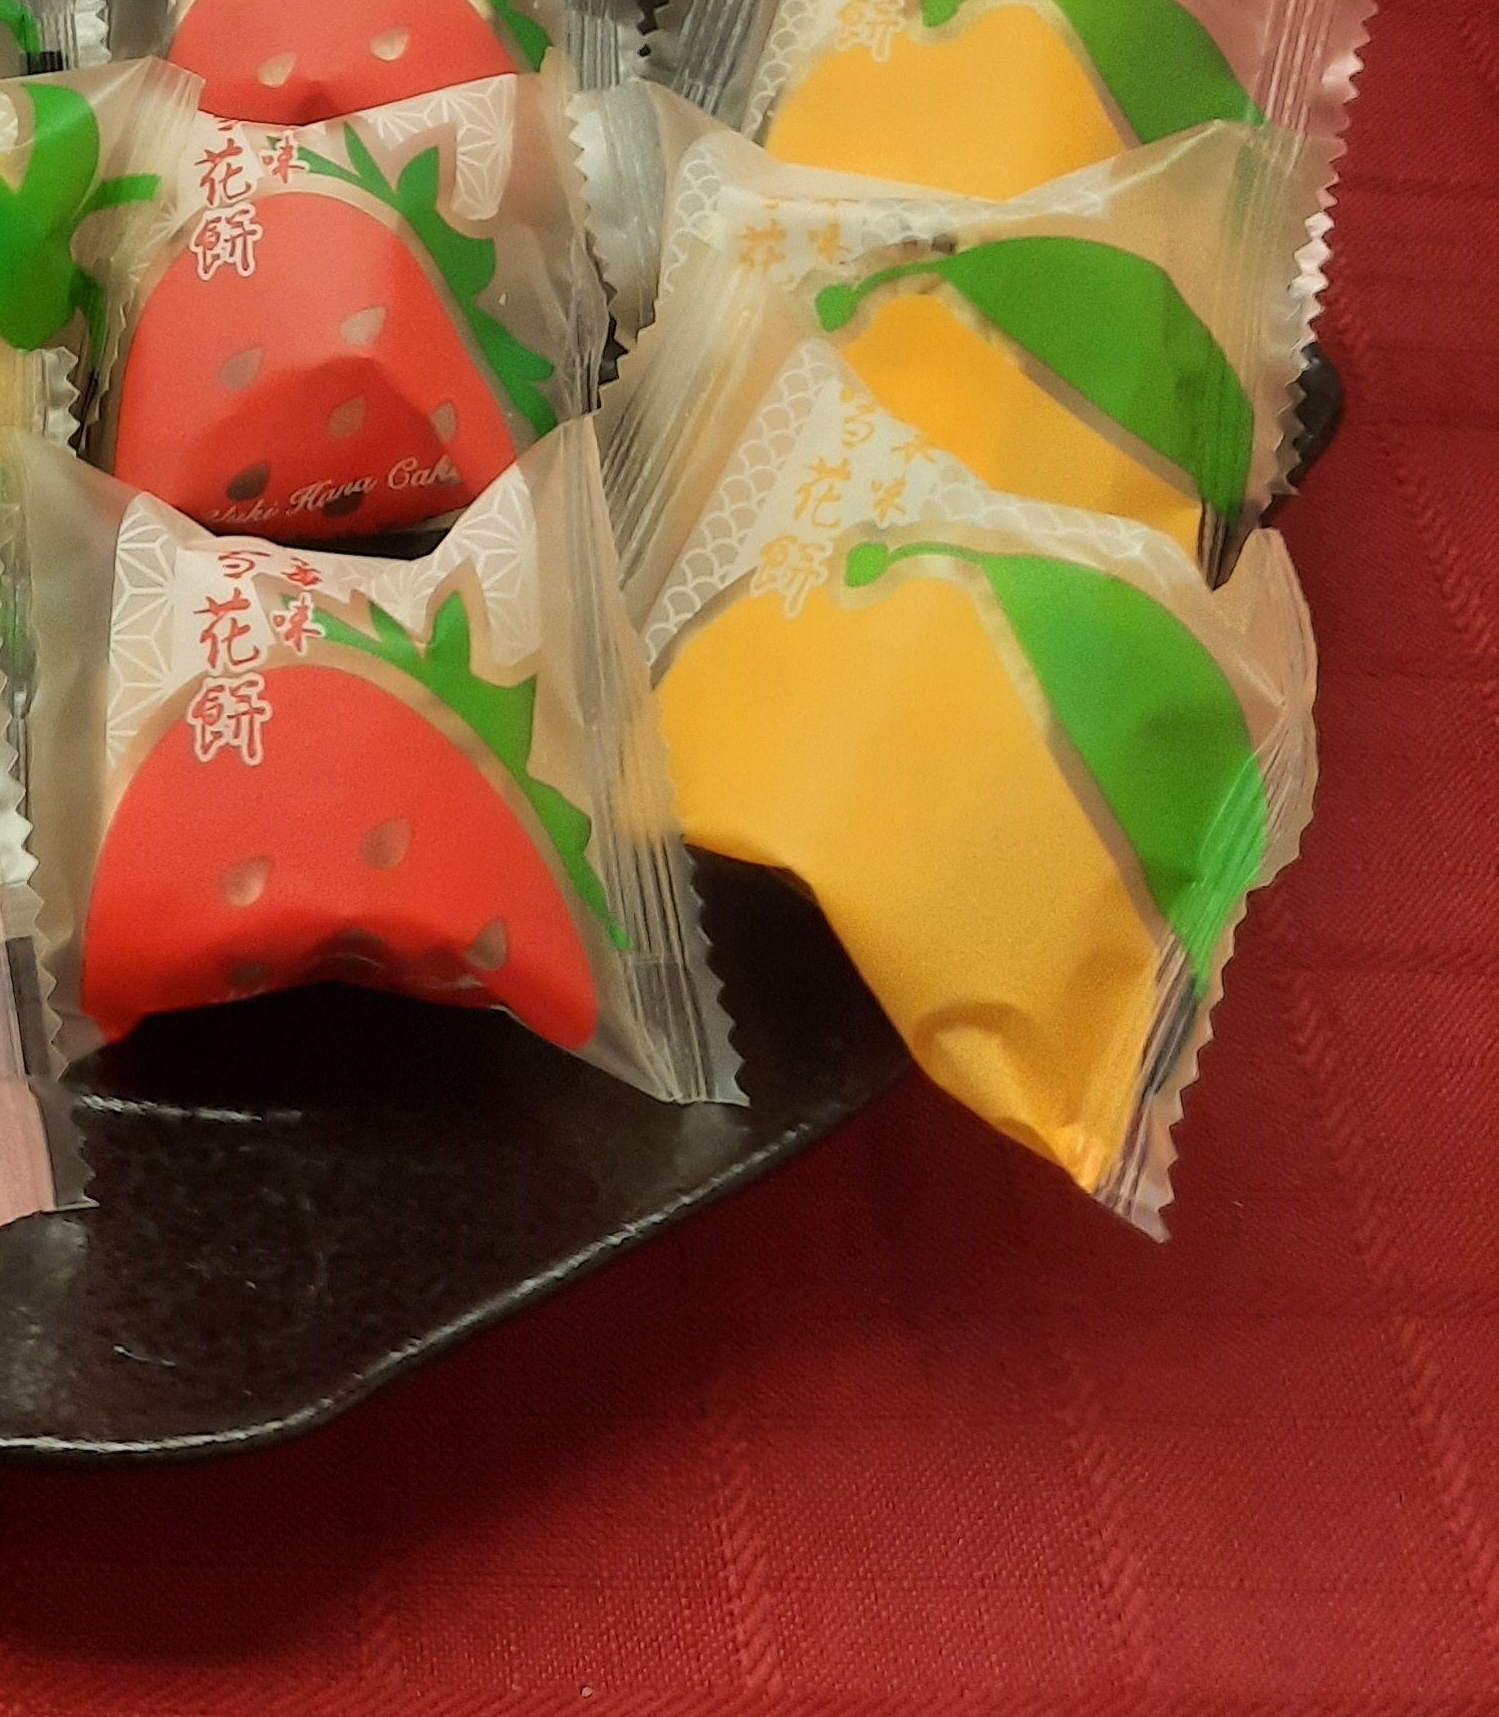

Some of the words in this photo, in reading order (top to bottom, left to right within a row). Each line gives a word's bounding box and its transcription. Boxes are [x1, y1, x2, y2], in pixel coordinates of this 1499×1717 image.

[261, 135, 306, 185] 味
[193, 120, 260, 274] 花餅
[285, 475, 379, 517] Hana
